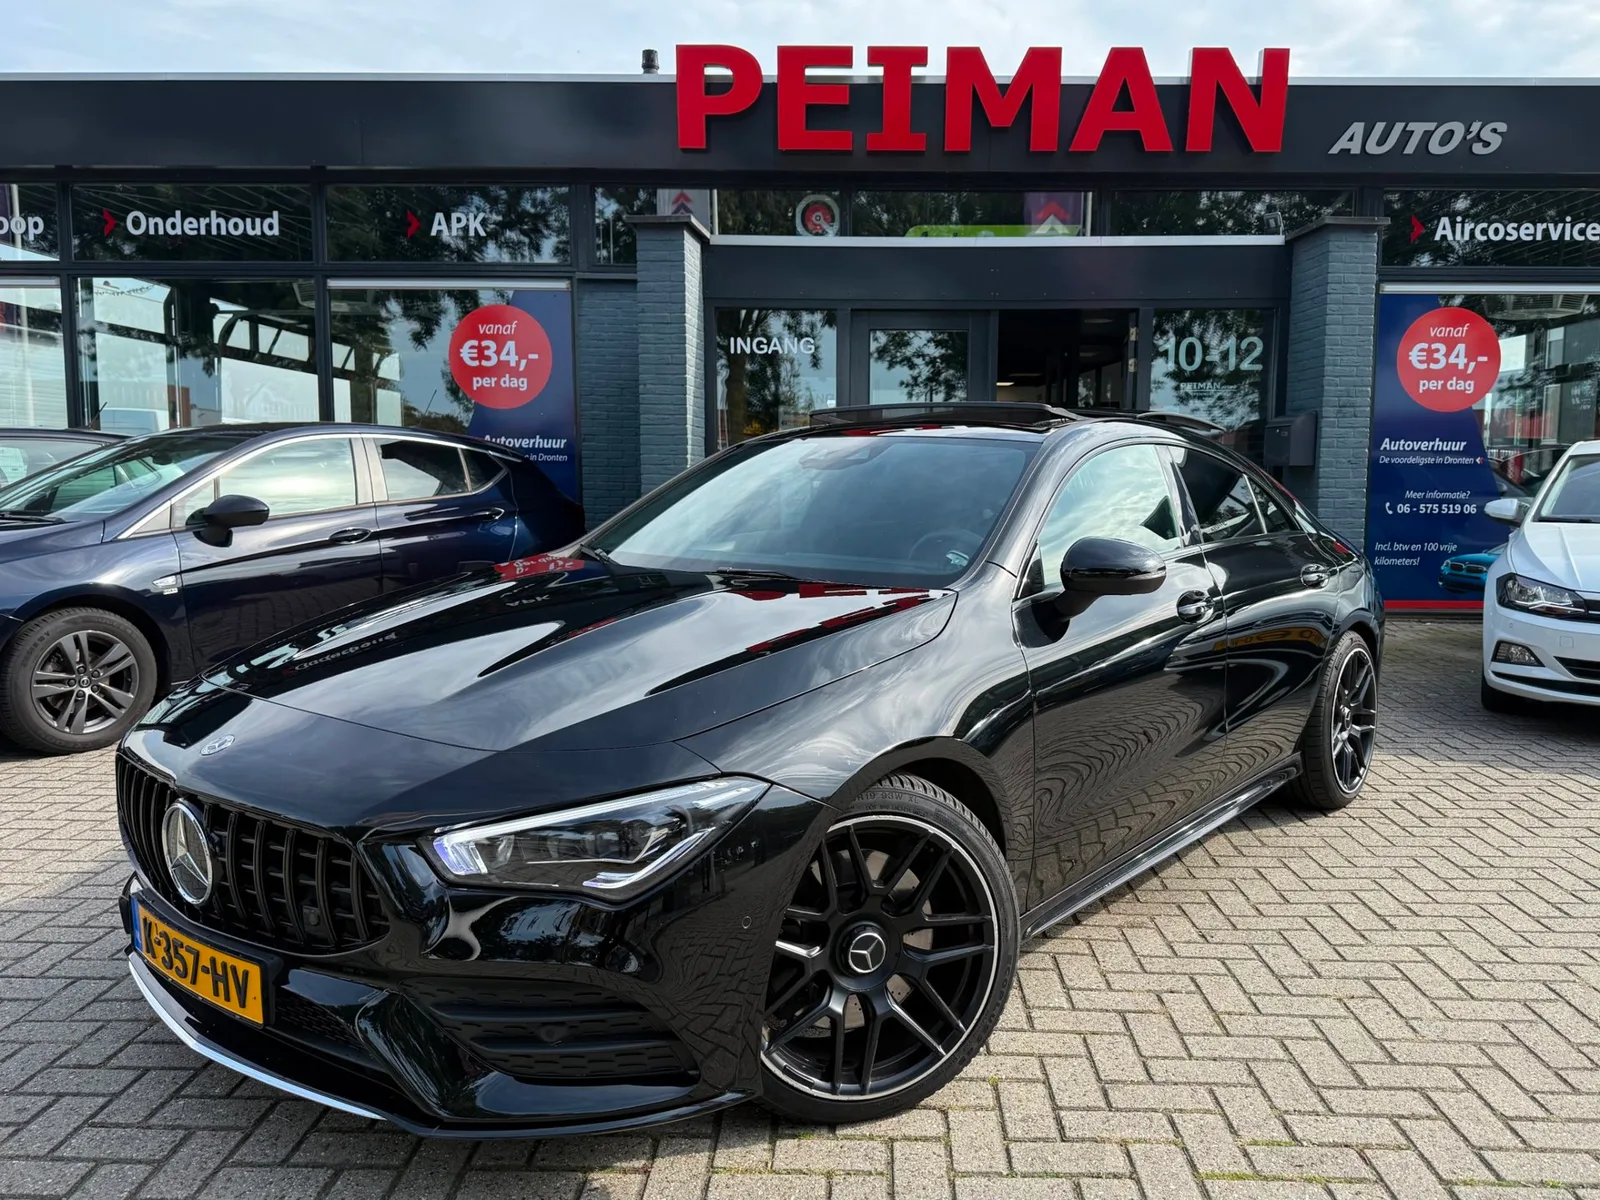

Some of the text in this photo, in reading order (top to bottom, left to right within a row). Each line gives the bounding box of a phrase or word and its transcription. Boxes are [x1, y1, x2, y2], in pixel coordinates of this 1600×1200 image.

[675, 44, 1290, 153] PEIMAN
[1328, 120, 1508, 155] AUTO'S
[126, 210, 280, 236] Onderhoud
[430, 212, 487, 237] APK
[1434, 216, 1600, 242] Aircoservice
[478, 321, 518, 335] vanaf
[1429, 323, 1470, 337] vanaf
[730, 337, 815, 354] INGANG
[1158, 335, 1264, 372] 10-12
[460, 339, 539, 371] €34,-
[1408, 342, 1488, 374] €34,-
[472, 373, 528, 392] per dag
[1419, 376, 1475, 394] per dag
[1380, 437, 1467, 451] Autoverhuur
[529, 453, 537, 461] in
[538, 453, 568, 462] Dronten
[1379, 455, 1474, 466] De voordeligste in Dronten
[1404, 490, 1471, 499] Meer informatie?
[1397, 504, 1411, 514] 06
[1418, 504, 1439, 514] 575
[1441, 504, 1462, 514] 519
[1463, 504, 1477, 514] 06
[1375, 542, 1392, 551] Incl.
[1393, 542, 1410, 551] btw
[1423, 542, 1439, 552] 100
[1440, 542, 1458, 553] vrije
[1374, 556, 1420, 566] kilometers!
[142, 916, 250, 1010] K-357-HV
